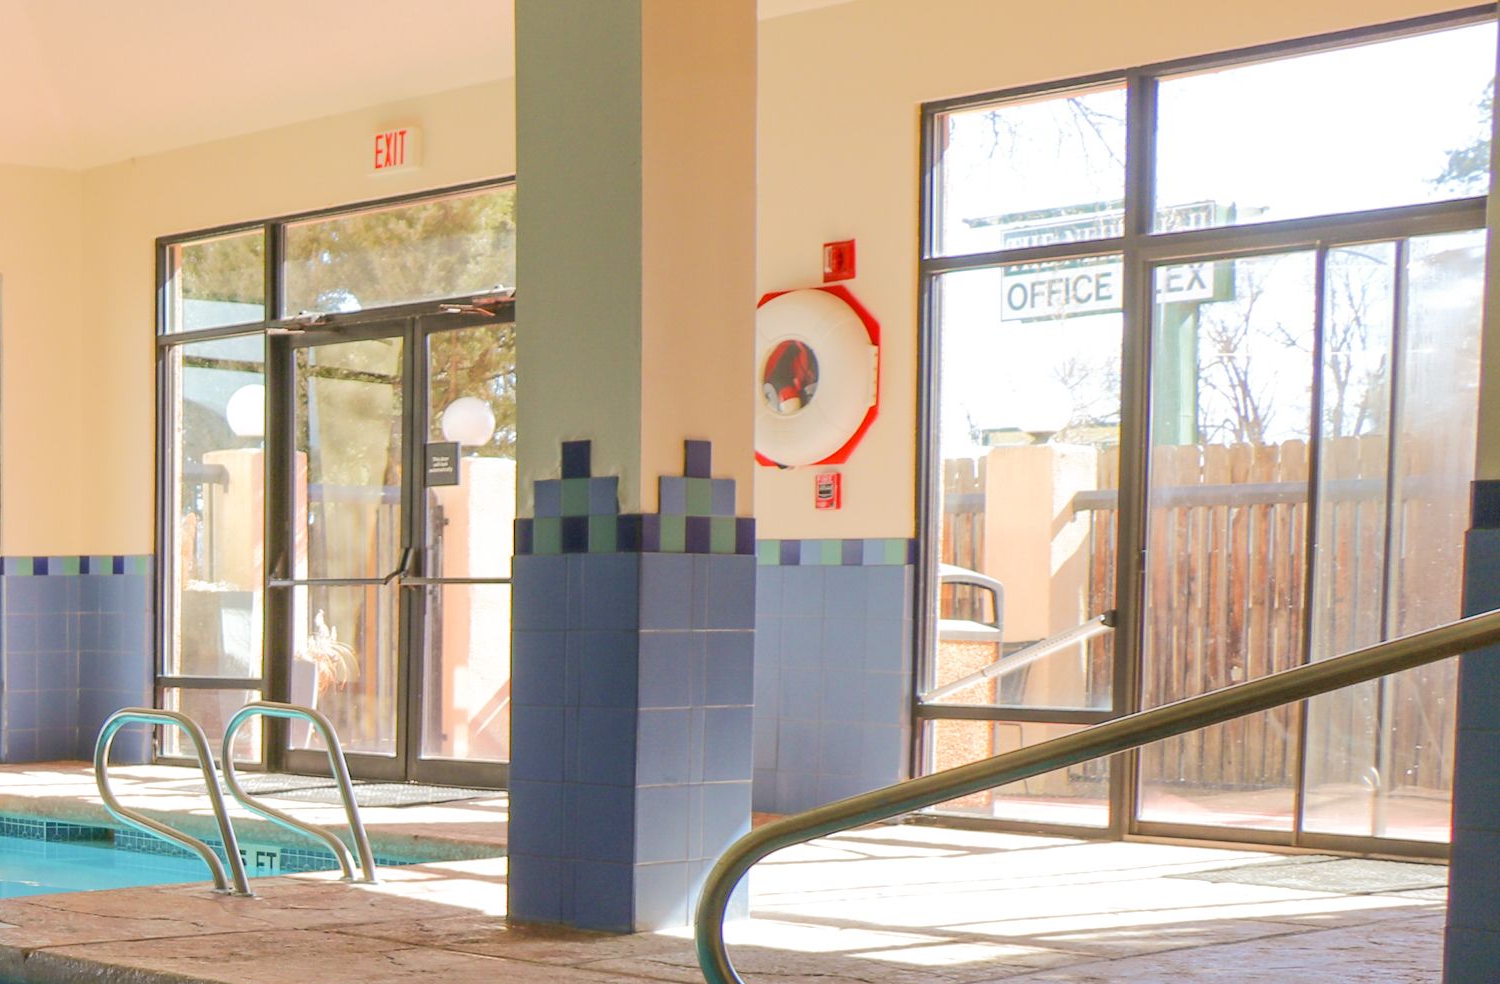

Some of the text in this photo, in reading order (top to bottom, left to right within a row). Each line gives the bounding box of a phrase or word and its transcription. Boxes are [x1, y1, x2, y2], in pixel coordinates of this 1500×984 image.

[375, 130, 407, 169] EXIT
[1007, 273, 1113, 311] OFFICE
[256, 851, 277, 869] FT
